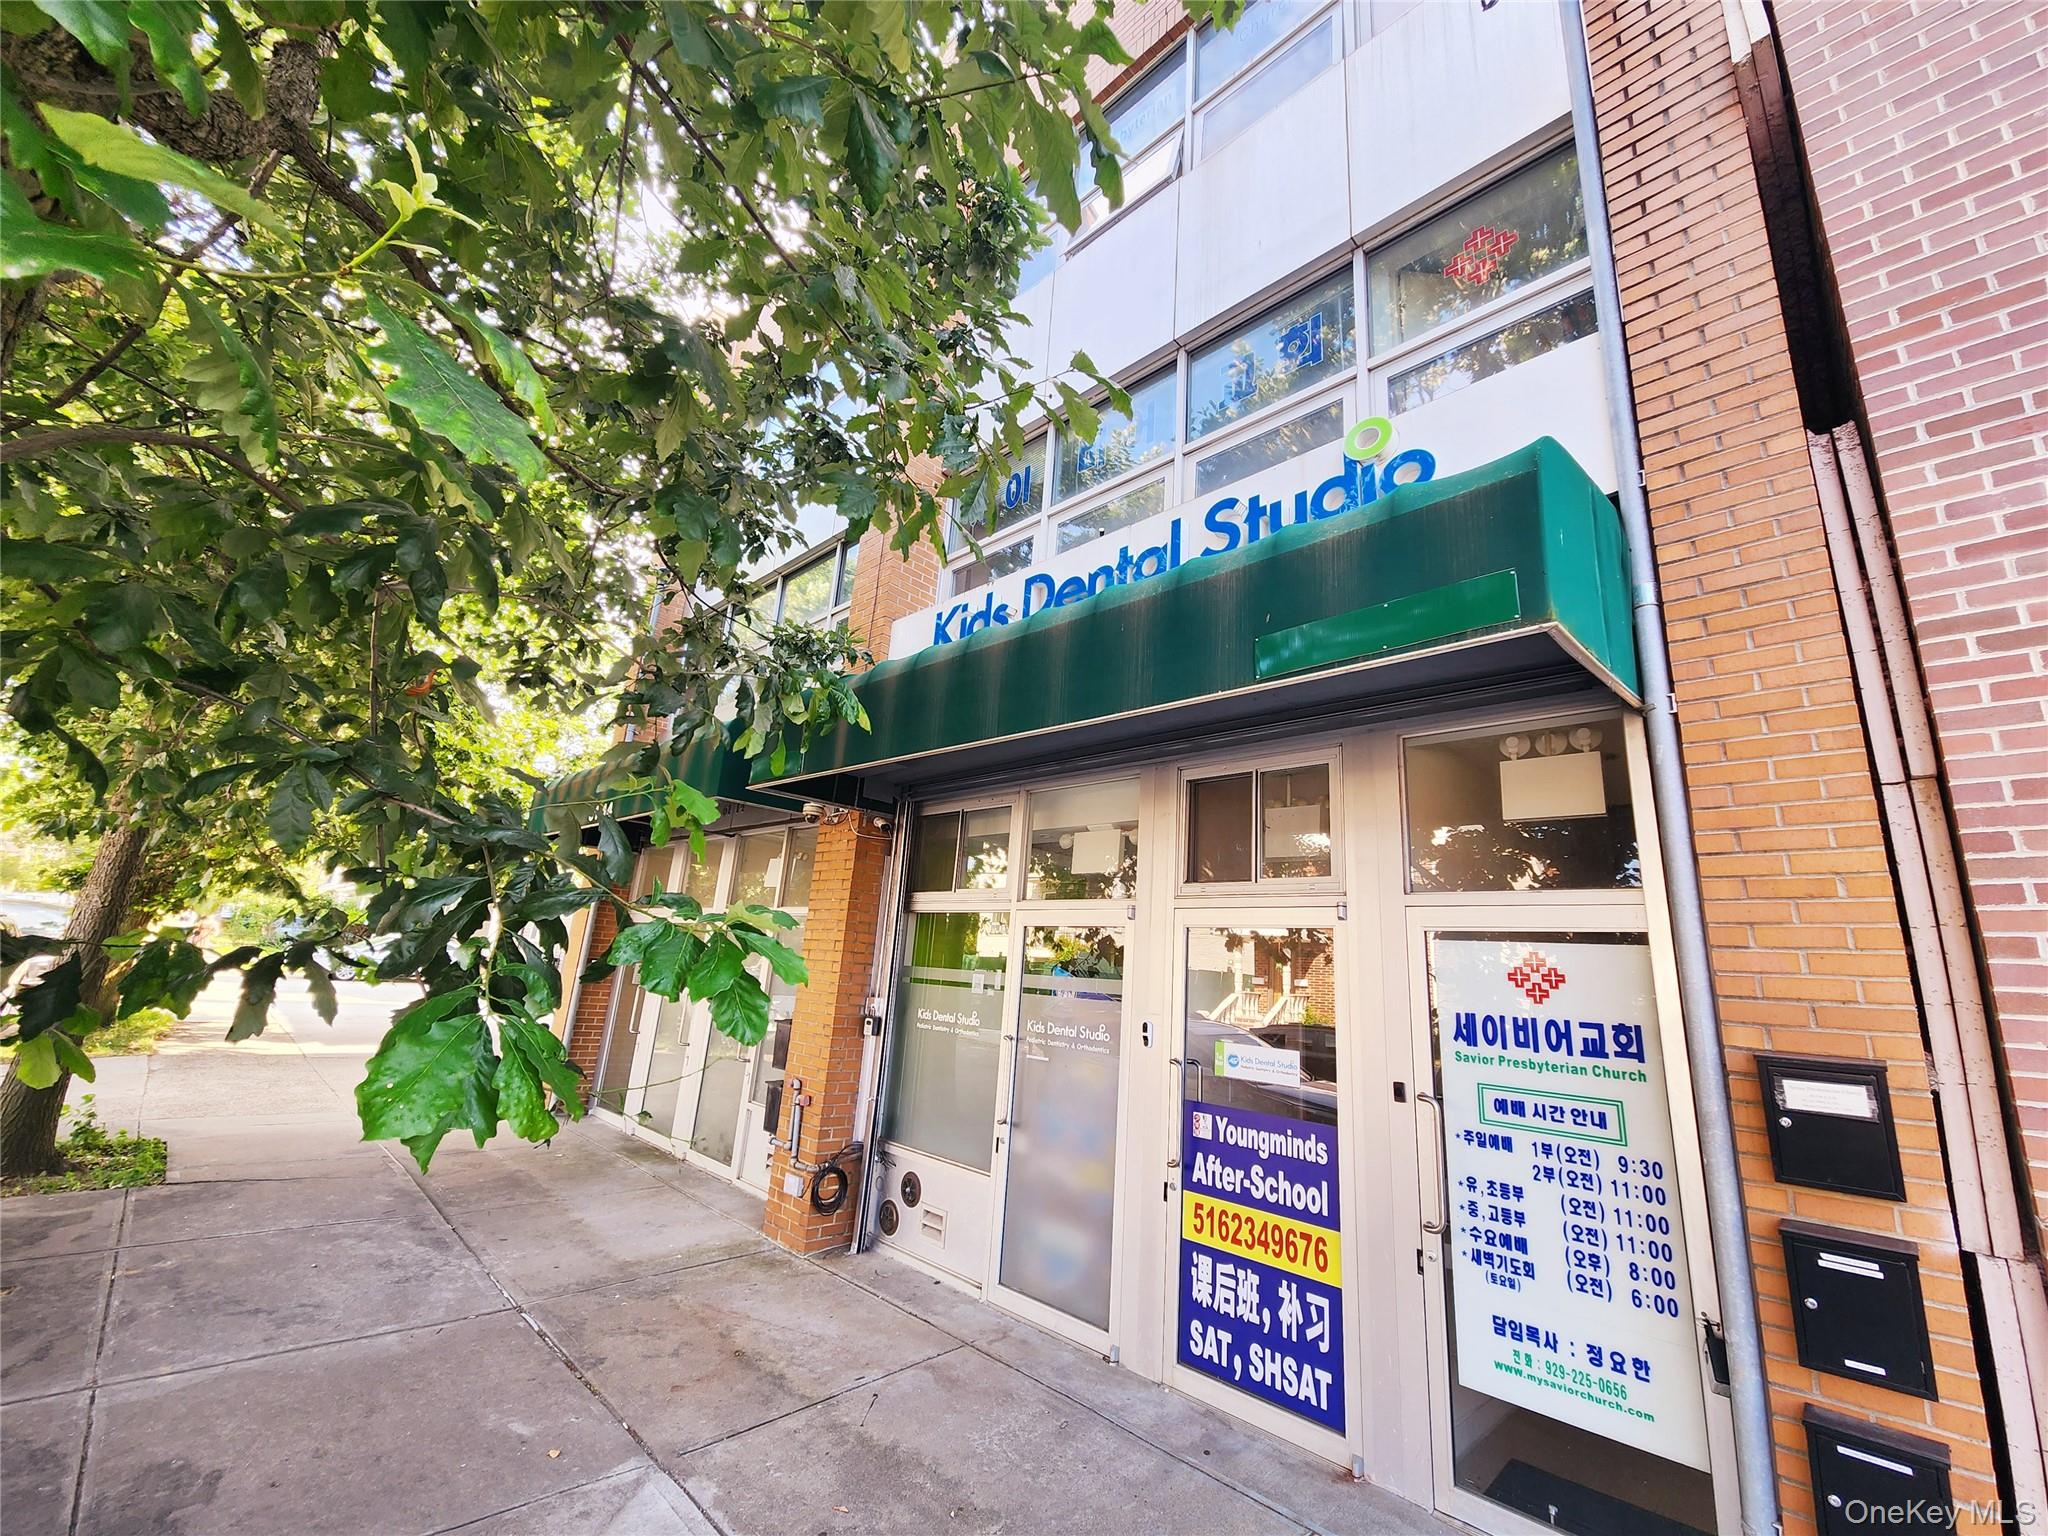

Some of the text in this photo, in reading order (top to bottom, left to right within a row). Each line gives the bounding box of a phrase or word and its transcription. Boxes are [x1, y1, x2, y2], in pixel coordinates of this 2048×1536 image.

[933, 416, 1436, 647] Kids Dental Studio
[918, 1008, 980, 1026] Kids Dental Studio
[1026, 1020, 1110, 1042] Kids Dental Studio
[1453, 1012, 1646, 1063] 세이비어교회
[1240, 1056, 1298, 1070] Kids Dental Studio
[1455, 1050, 1648, 1082] Savior Presbyterian Church
[1493, 1097, 1608, 1130] 예배 시간 안내
[1215, 1115, 1328, 1165] Youngminds
[1192, 1152, 1329, 1217] After-School
[1618, 1155, 1663, 1180] 9:30
[1611, 1179, 1667, 1206] 11:00
[1561, 1194, 1605, 1224] (오전)
[1613, 1207, 1670, 1236] 11:00
[1193, 1202, 1328, 1273] 5162349676
[1563, 1221, 1607, 1251] (오전)
[1616, 1234, 1673, 1263] 11:00
[1485, 1269, 1521, 1293] (토요일)
[1565, 1246, 1610, 1277] (오후)
[1629, 1262, 1676, 1290] 8:00
[1567, 1269, 1612, 1302] (오전)
[1632, 1289, 1679, 1318] 6:00
[1492, 1315, 1558, 1353] 담임목사
[1249, 1343, 1332, 1411] SHSAT
[1494, 1359, 1655, 1422] www.mysaviorchurch.com
[1545, 1360, 1628, 1400] 929-225-0656
